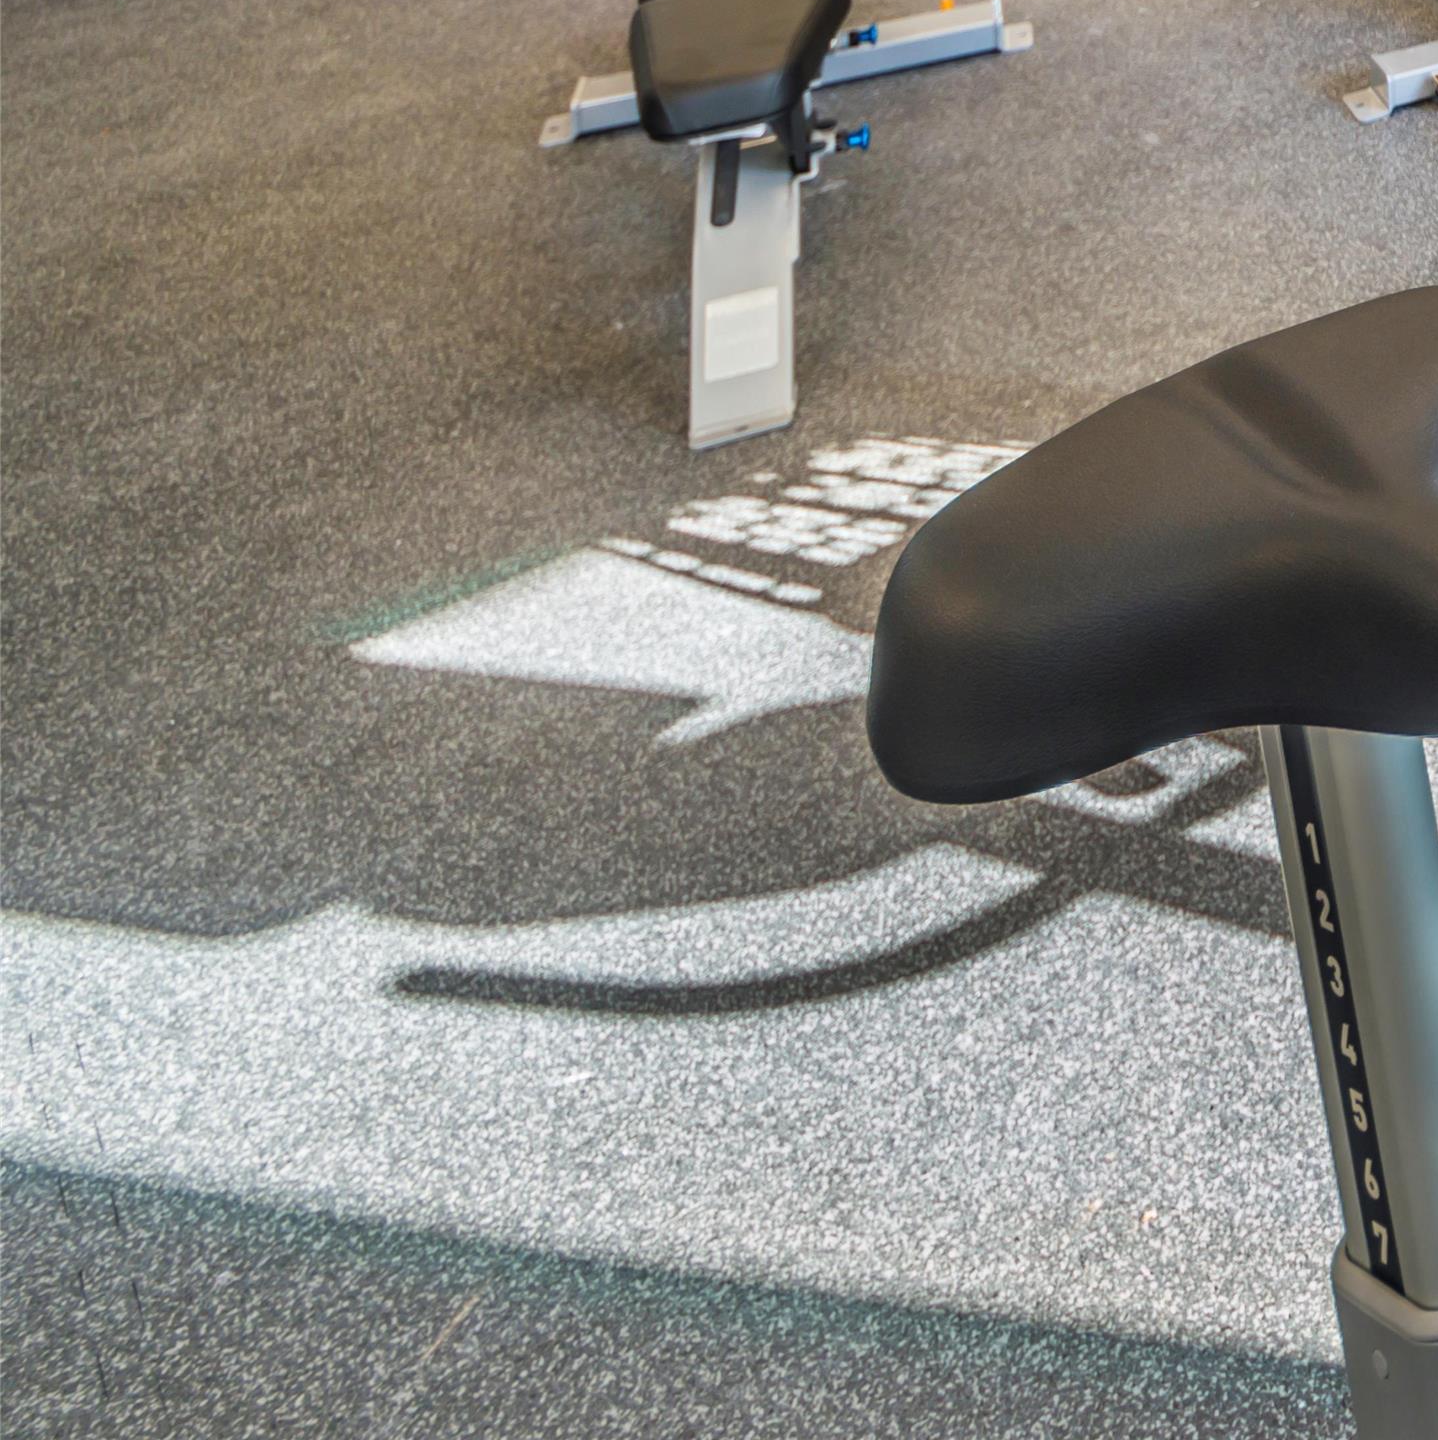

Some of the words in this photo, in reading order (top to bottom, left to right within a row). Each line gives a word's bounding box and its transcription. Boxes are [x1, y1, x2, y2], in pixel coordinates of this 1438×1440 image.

[1305, 822, 1321, 864] 1
[1315, 890, 1334, 933] 2
[1327, 956, 1345, 998] 3
[1340, 1023, 1358, 1066] 4
[1349, 1089, 1368, 1133] 5
[1363, 1158, 1380, 1201] 6
[1371, 1221, 1388, 1265] 7
